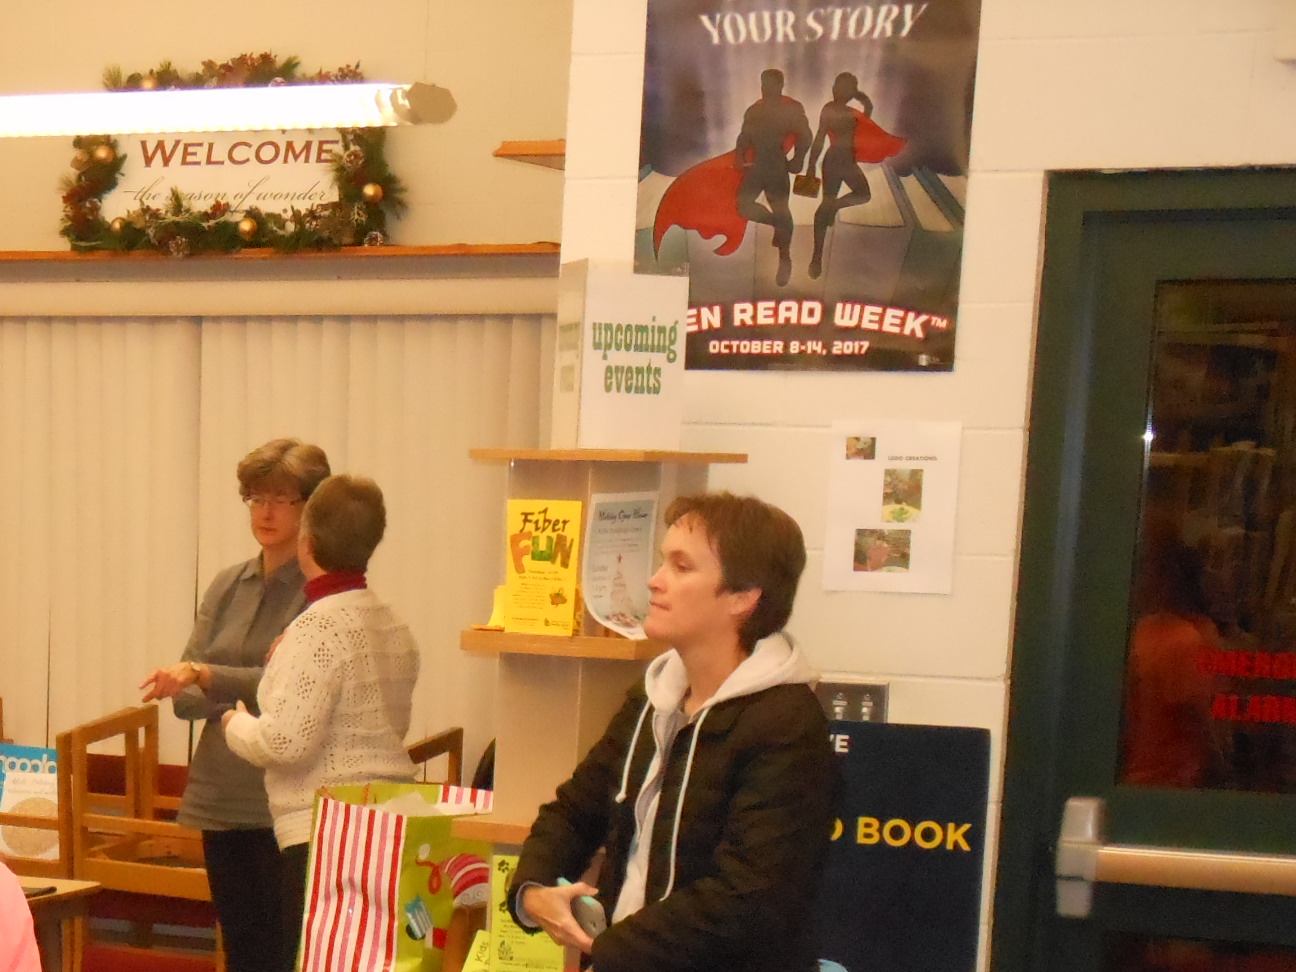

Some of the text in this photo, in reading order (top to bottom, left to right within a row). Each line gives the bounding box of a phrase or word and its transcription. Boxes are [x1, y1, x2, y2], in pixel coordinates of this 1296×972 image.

[699, 3, 929, 45] YOUR STORY
[139, 139, 340, 168] WELCOME
[123, 176, 164, 201] the
[164, 190, 227, 201] sason
[230, 174, 268, 214] of
[686, 305, 722, 332] EN
[733, 300, 823, 327] READ
[592, 316, 680, 363] upcoming
[708, 340, 870, 357] OCTOBER 8-14, 2017
[603, 359, 662, 395] events
[519, 507, 571, 533] Fiber
[510, 531, 574, 575] FUN
[857, 816, 972, 851] BOOK
